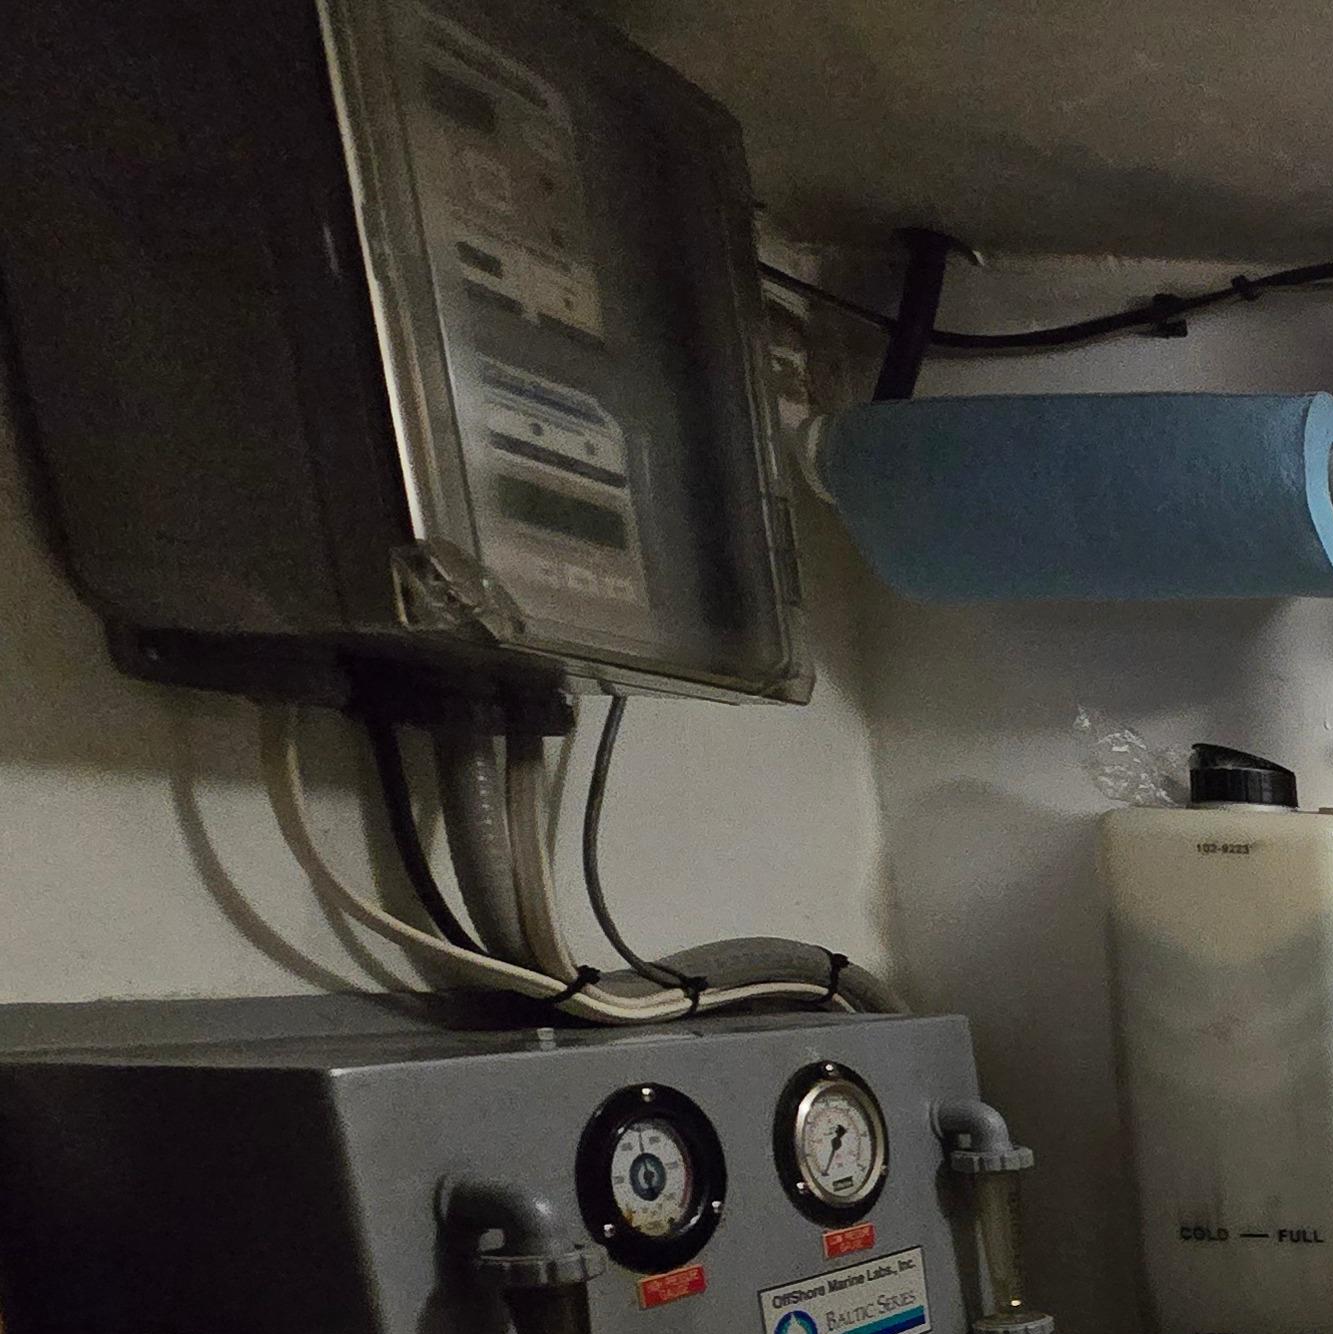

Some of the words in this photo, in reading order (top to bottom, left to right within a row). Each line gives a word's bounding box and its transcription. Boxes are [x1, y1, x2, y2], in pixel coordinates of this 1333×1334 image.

[1180, 1226, 1230, 1241] COLD
[1278, 1228, 1325, 1243] FULL
[828, 1273, 866, 1294] Marine
